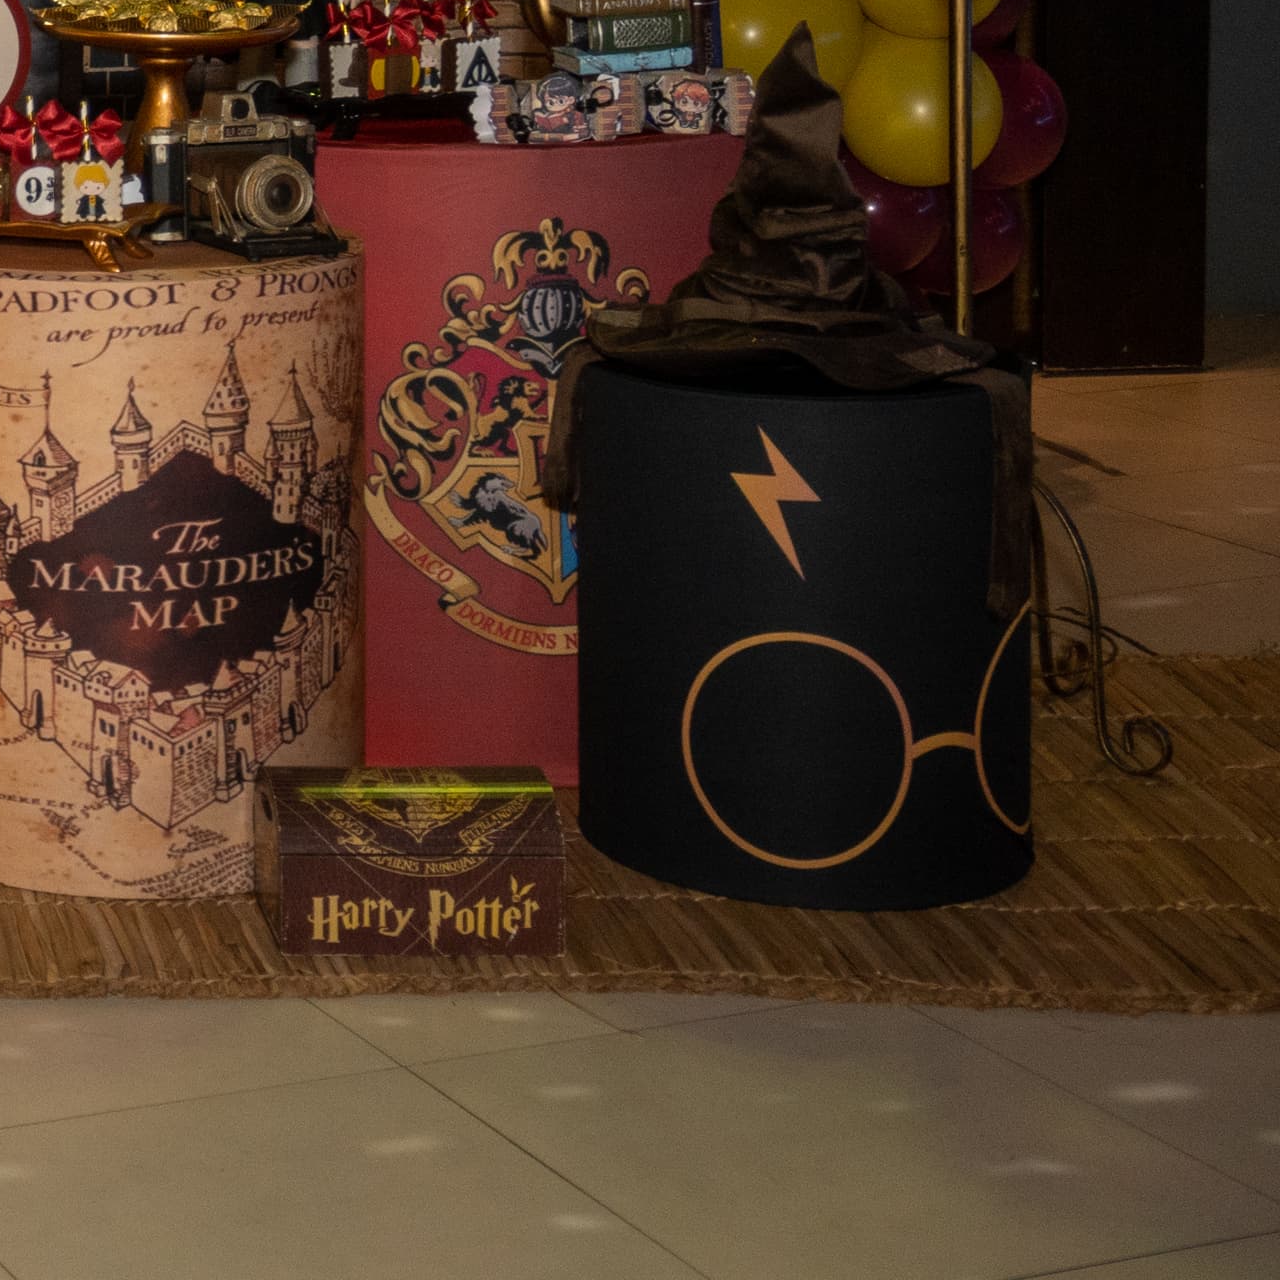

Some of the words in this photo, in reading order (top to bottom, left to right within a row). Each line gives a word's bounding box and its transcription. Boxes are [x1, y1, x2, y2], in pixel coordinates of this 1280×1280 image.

[211, 277, 241, 302] &
[256, 267, 358, 299] PRONGS
[46, 330, 95, 343] are
[72, 306, 201, 367] proud
[203, 312, 227, 334] to
[239, 300, 319, 338] present
[151, 517, 224, 555] The
[29, 537, 314, 593] MARAUDER'S
[392, 532, 454, 584] DRACO
[455, 601, 558, 650] DORMIENS
[129, 595, 239, 632] MAP
[307, 894, 415, 944] Harry
[428, 888, 540, 950] Potter
